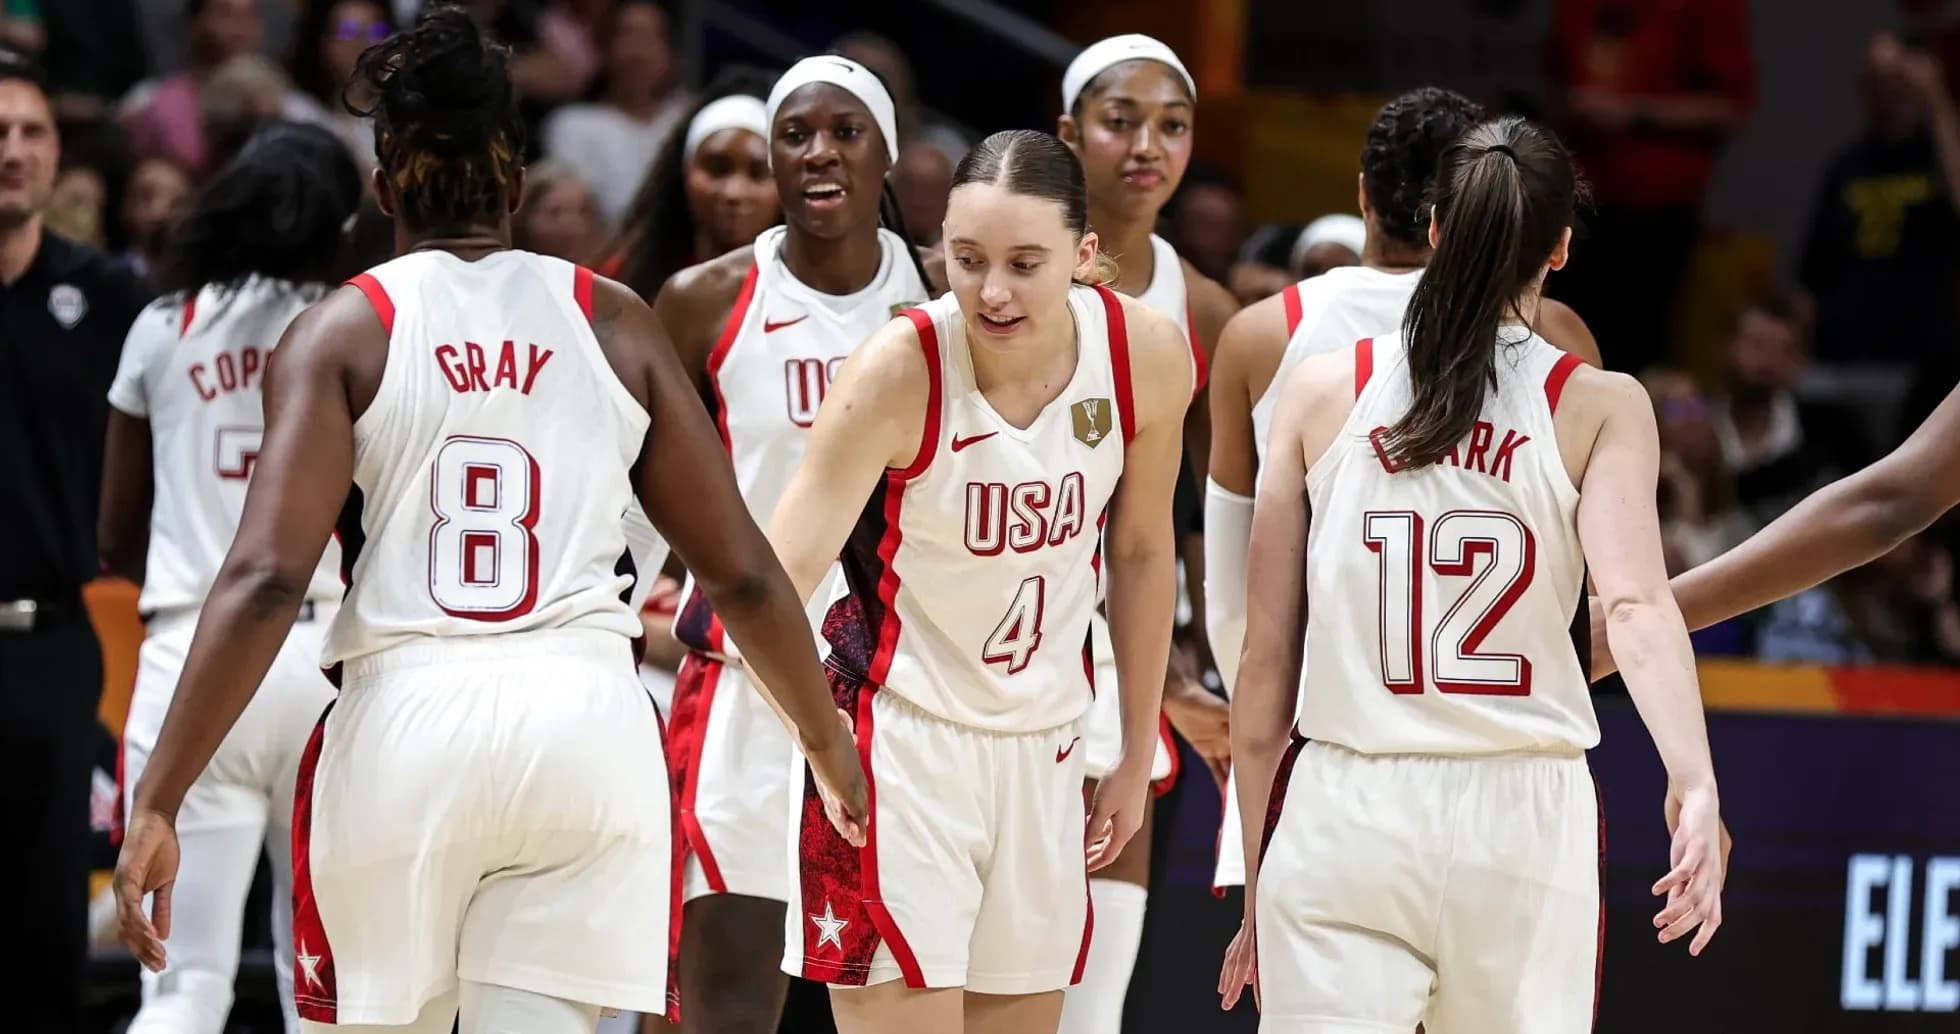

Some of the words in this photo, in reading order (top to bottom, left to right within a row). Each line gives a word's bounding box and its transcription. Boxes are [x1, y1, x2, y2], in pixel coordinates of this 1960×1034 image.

[435, 341, 553, 395] GRAY
[1369, 420, 1531, 482] CRK
[429, 435, 541, 622] 8
[964, 472, 1085, 556] USA
[982, 575, 1045, 674] 4
[1363, 510, 1536, 696] 12
